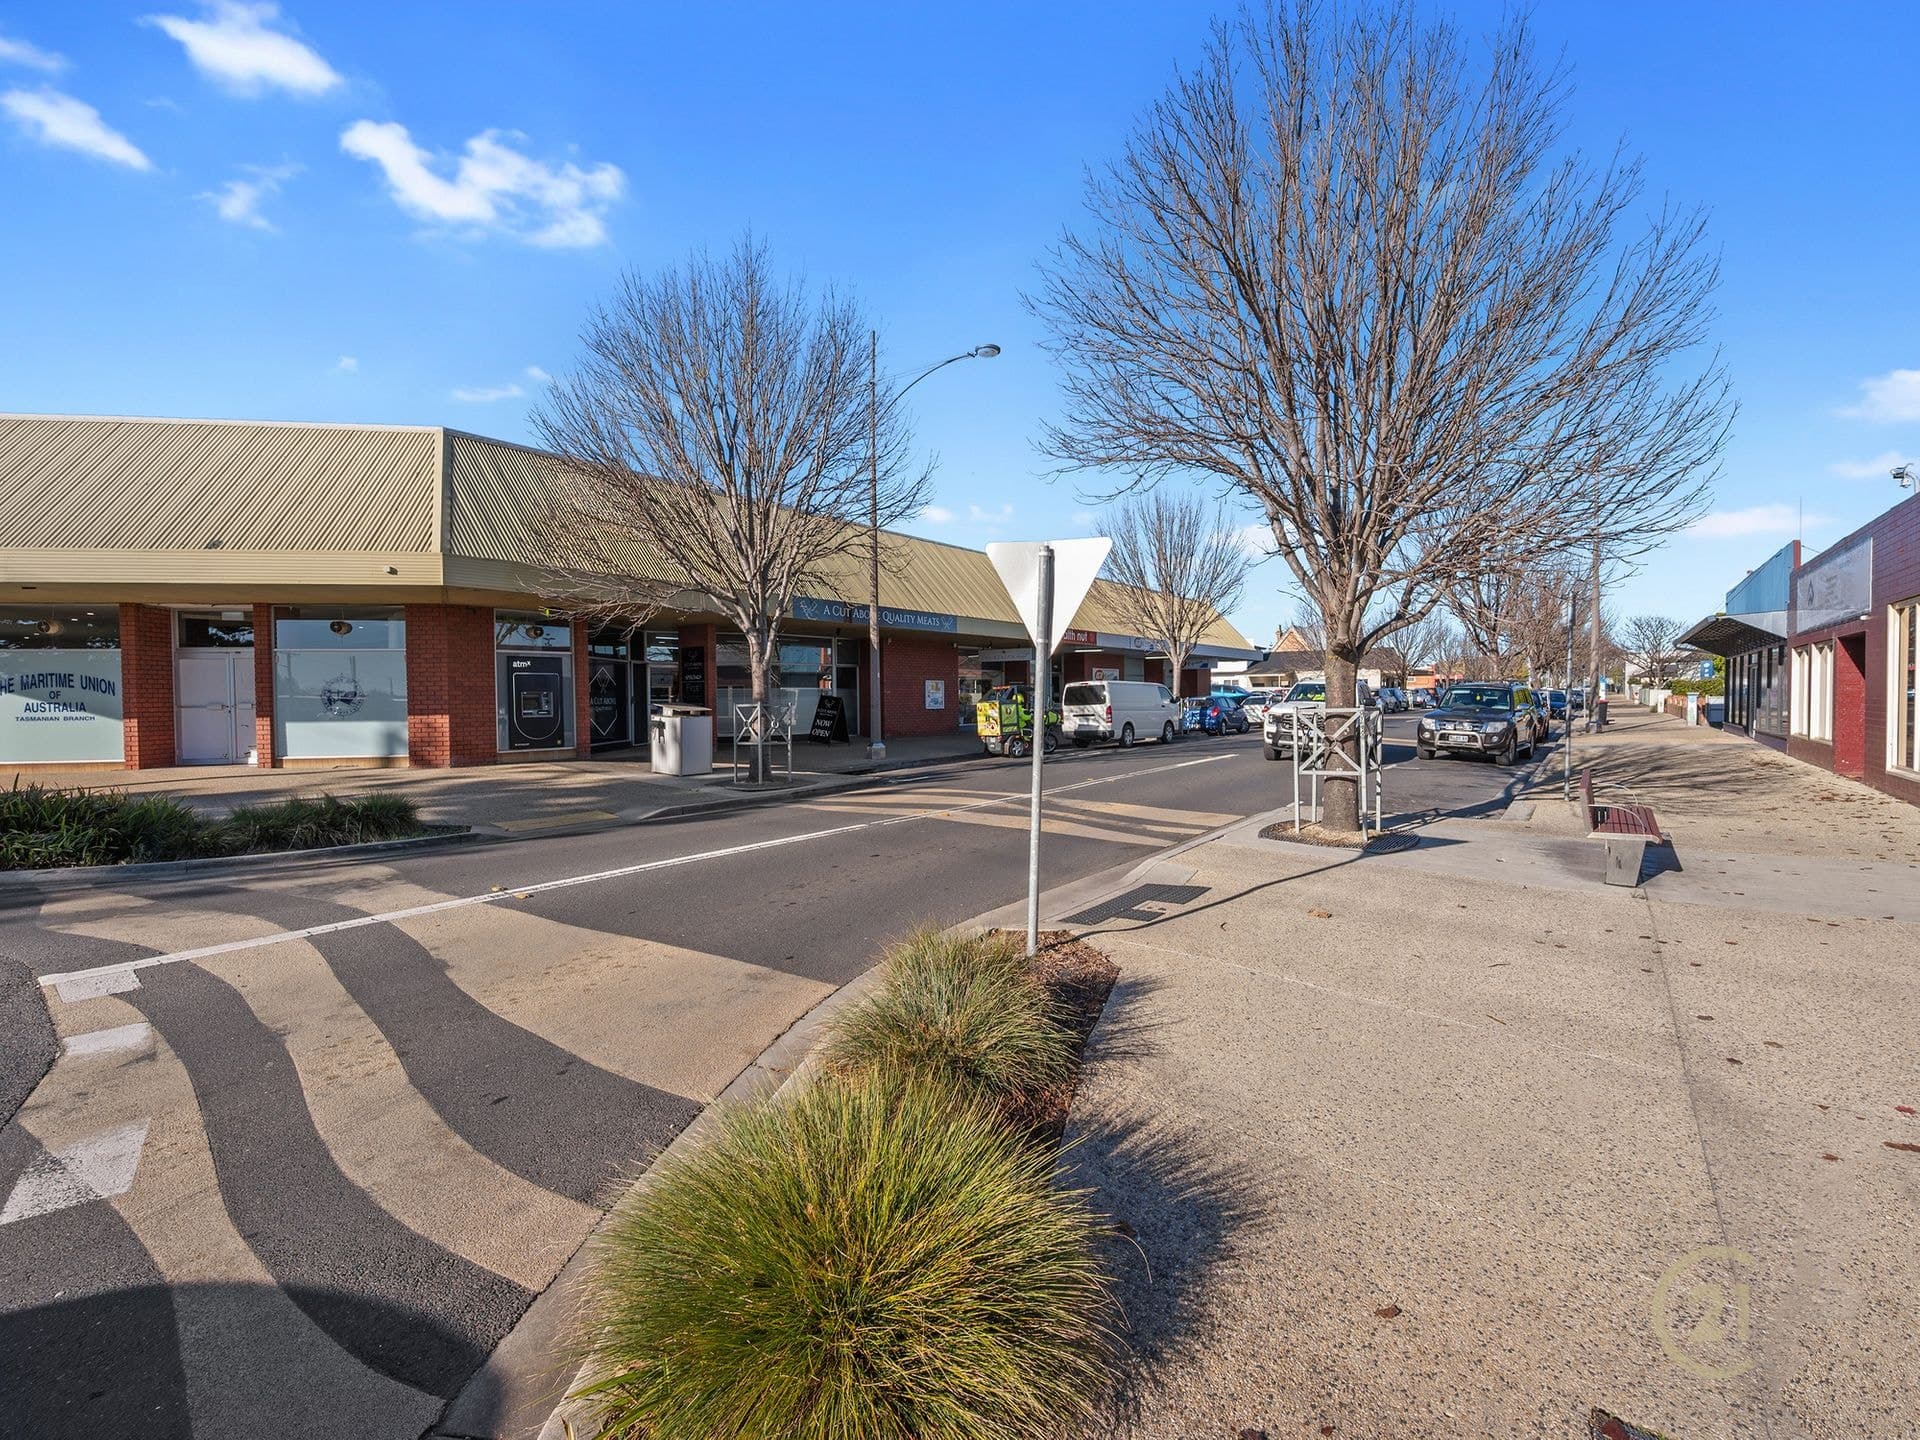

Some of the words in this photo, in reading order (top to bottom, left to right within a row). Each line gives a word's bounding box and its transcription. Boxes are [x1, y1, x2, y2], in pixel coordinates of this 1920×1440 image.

[823, 605, 831, 615] A
[832, 605, 851, 617] CUT
[852, 608, 881, 621] ABO
[882, 610, 916, 625] QUALITY
[916, 615, 940, 626] MEATS
[0, 677, 15, 696] HE
[20, 672, 75, 690] MARITIME
[80, 674, 116, 696] UNION
[48, 690, 62, 700] OF
[24, 701, 87, 713] AUSTRALIA
[815, 719, 833, 727] NOW
[811, 728, 831, 737] OPEN
